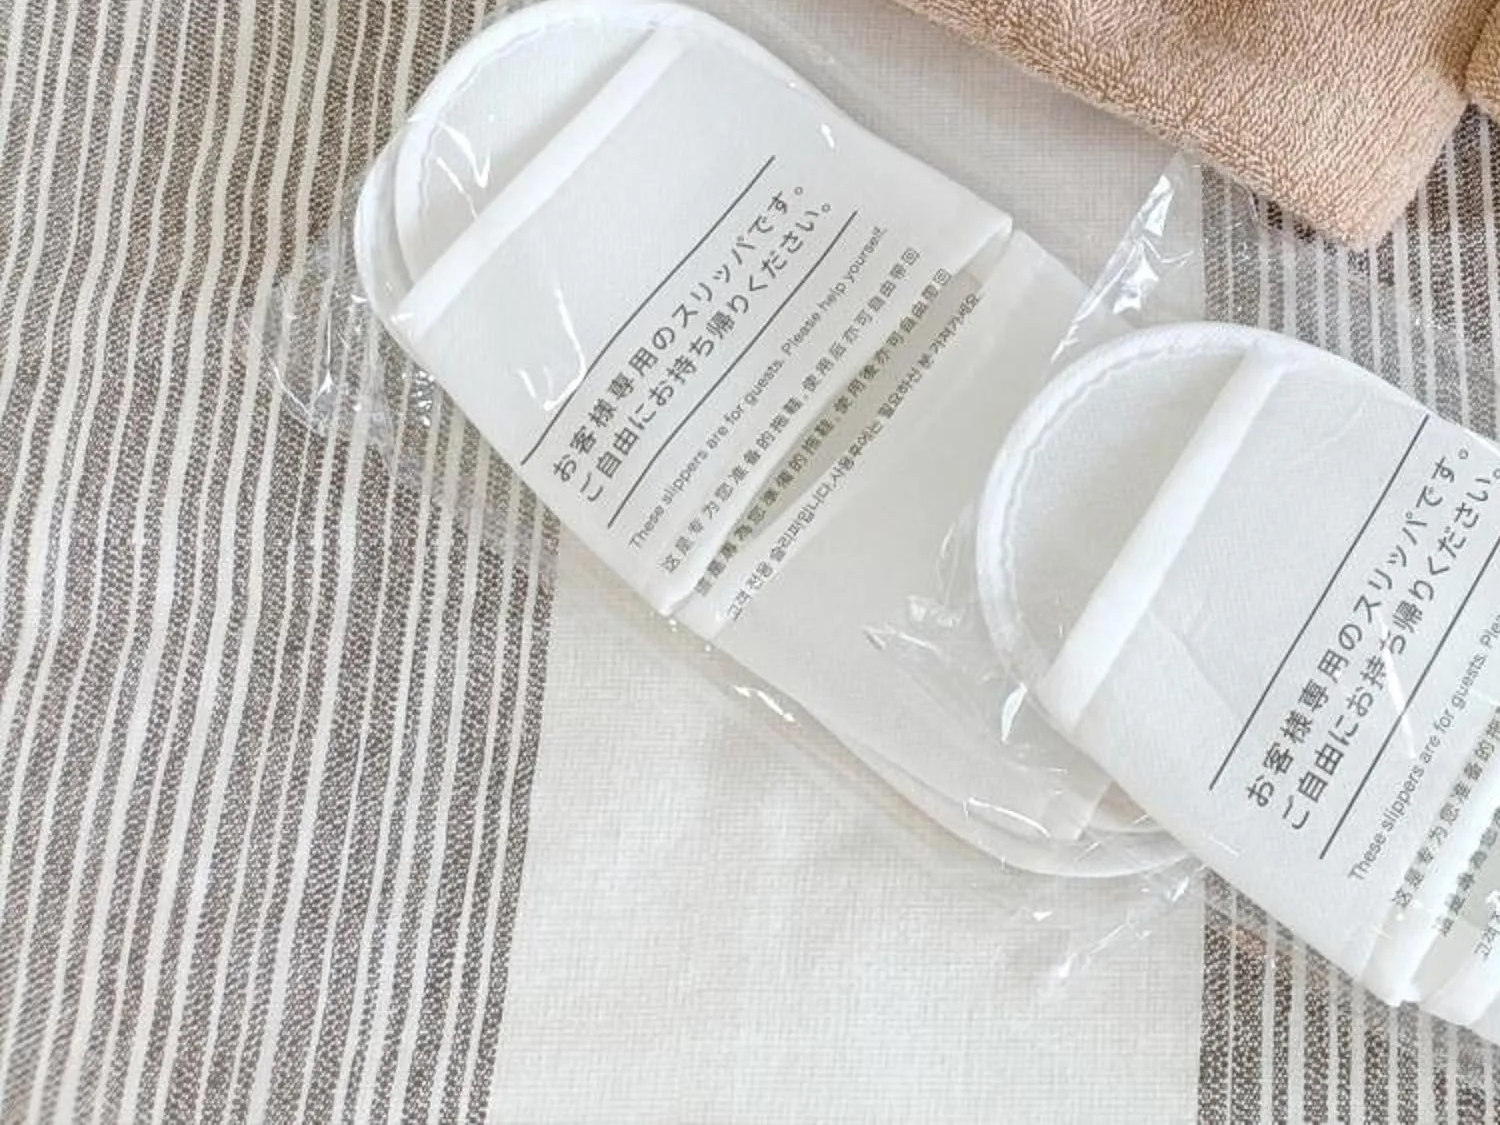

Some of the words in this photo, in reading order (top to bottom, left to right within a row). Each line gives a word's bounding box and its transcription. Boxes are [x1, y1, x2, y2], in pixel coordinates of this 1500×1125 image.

[553, 187, 803, 482] お客様専用のスリッパです。
[580, 204, 830, 502] ご自由にお持ち帰りください。
[629, 505, 665, 548] These
[661, 450, 708, 505] slippers
[706, 426, 729, 449] are
[723, 404, 744, 425] for
[781, 312, 821, 356] Please
[817, 282, 846, 311] help
[1246, 449, 1468, 807] お客様専用のスリッパです。
[1347, 832, 1387, 880] These
[1381, 765, 1424, 832] slippers
[1419, 735, 1440, 764] are
[1433, 708, 1454, 733] for
